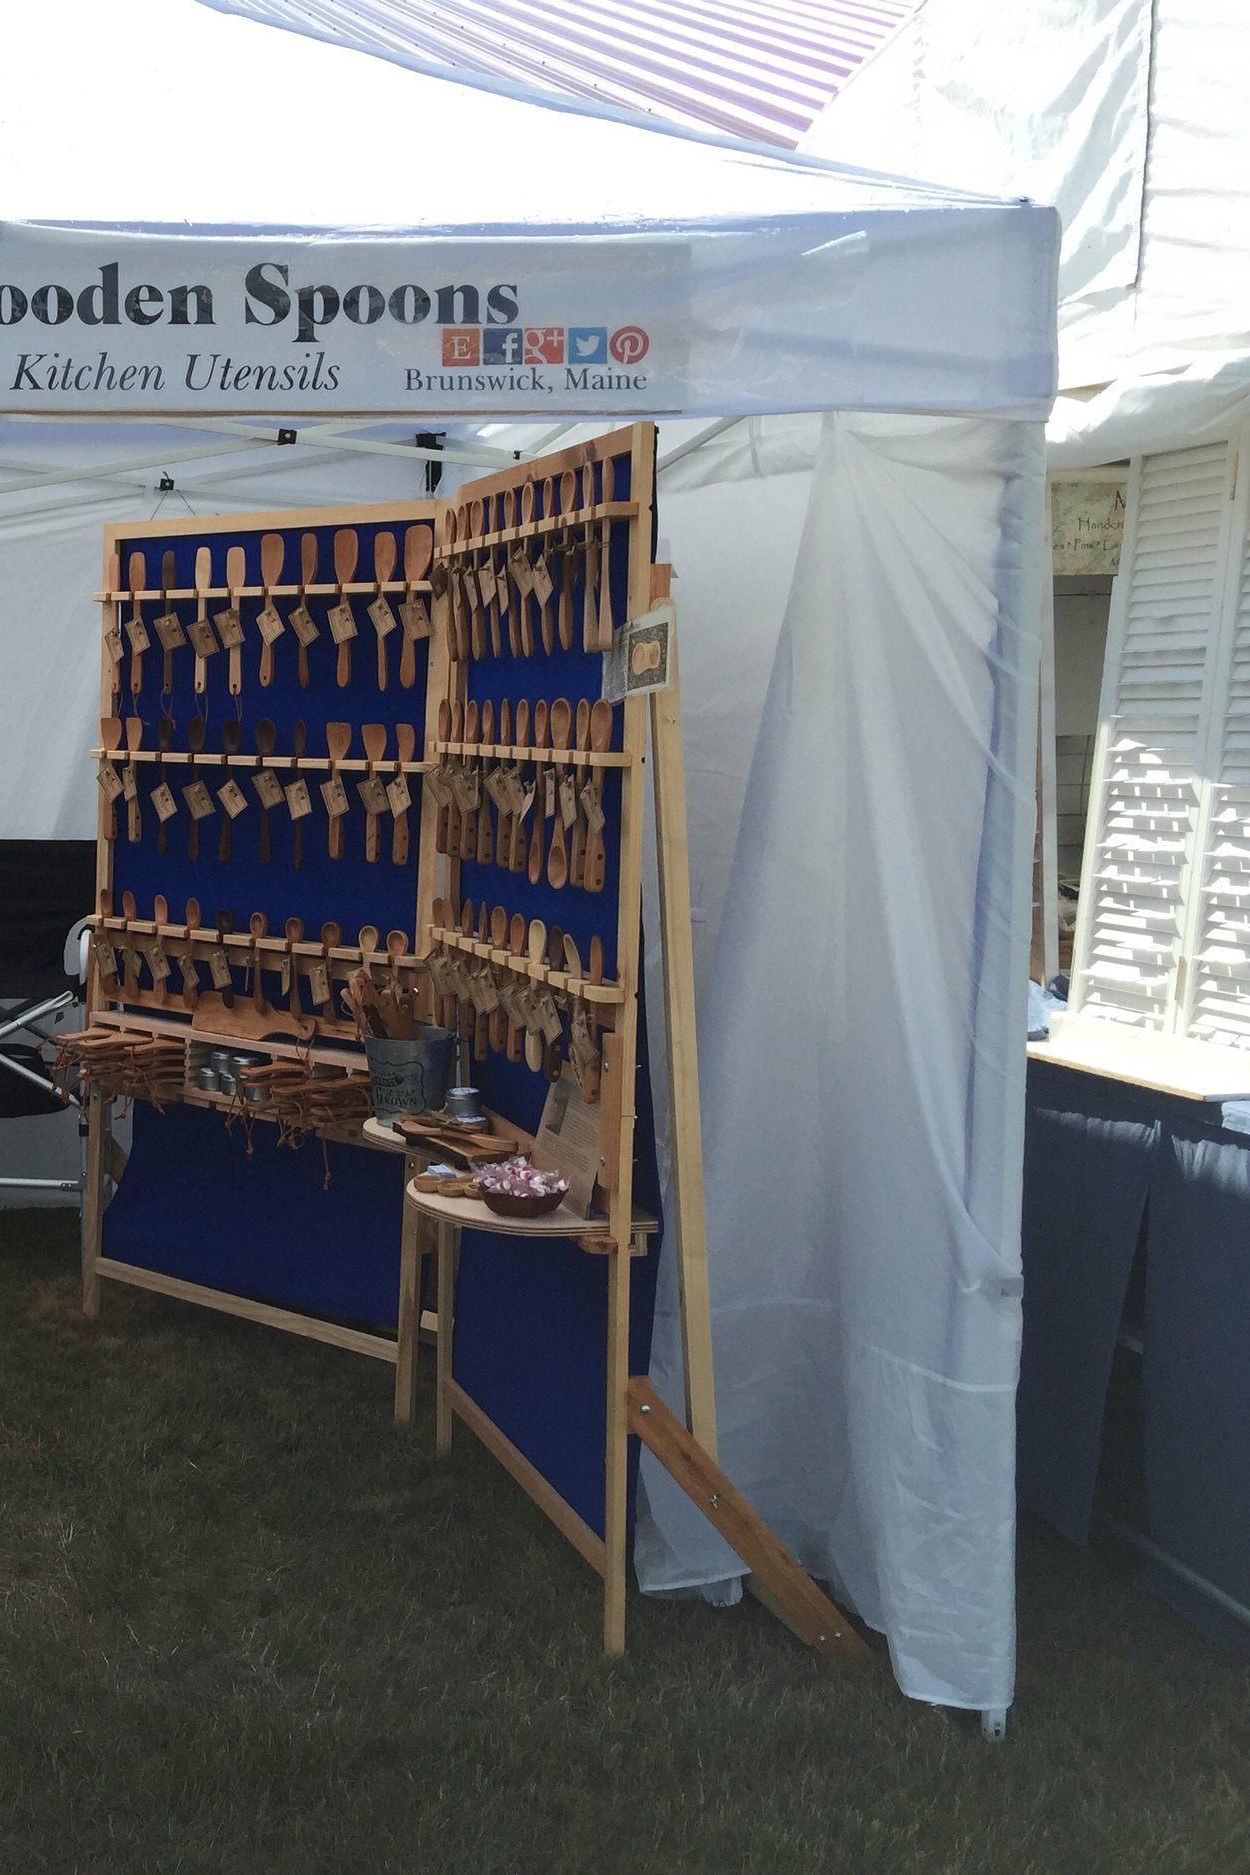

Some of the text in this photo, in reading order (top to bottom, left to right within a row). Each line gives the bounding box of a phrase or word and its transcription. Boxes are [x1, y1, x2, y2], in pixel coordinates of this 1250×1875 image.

[245, 262, 519, 343] Spoons
[10, 352, 165, 391] Kitchen
[184, 352, 341, 391] Utensils
[404, 366, 647, 395] Brunswick, Maine
[375, 1086, 417, 1106] GROWN
